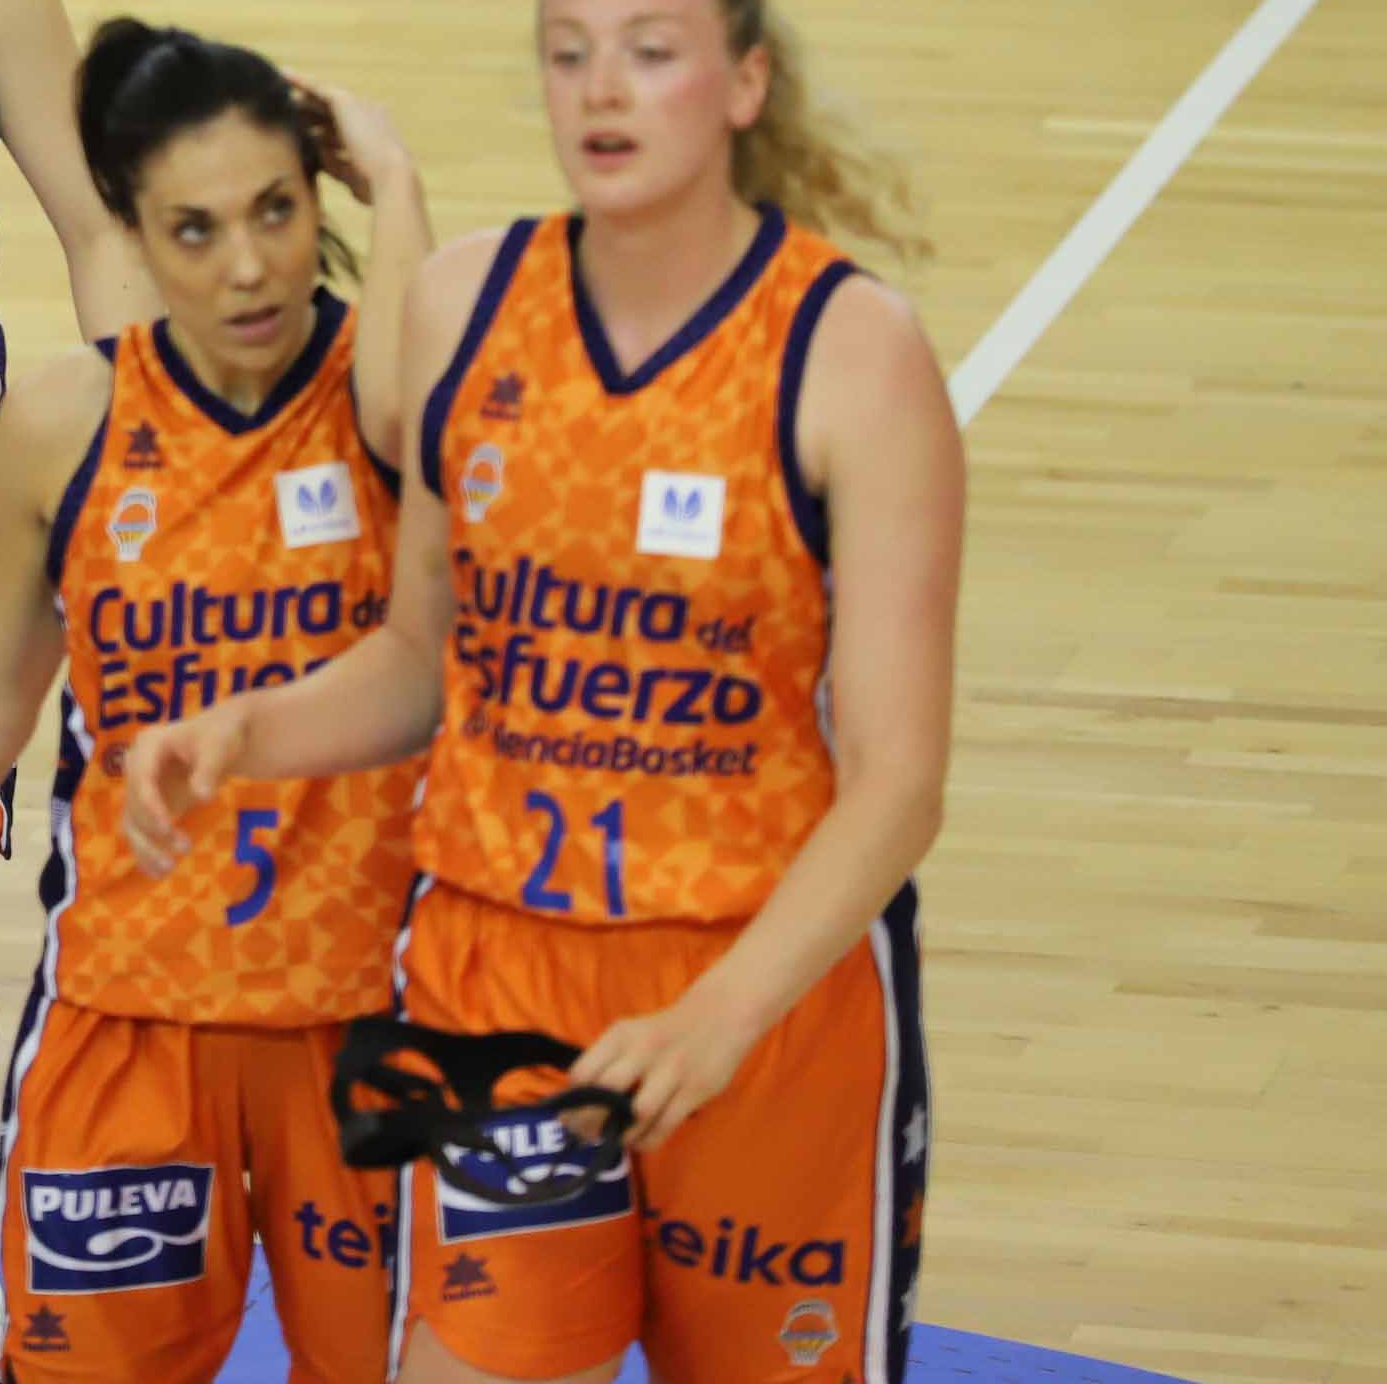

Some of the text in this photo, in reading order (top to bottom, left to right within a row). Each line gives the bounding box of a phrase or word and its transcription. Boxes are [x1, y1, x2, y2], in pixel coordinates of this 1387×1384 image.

[90, 581, 343, 654] Cultura
[697, 617, 755, 654] del
[225, 811, 280, 927] 5
[519, 790, 626, 917] 21
[30, 1177, 197, 1222] PULEVA
